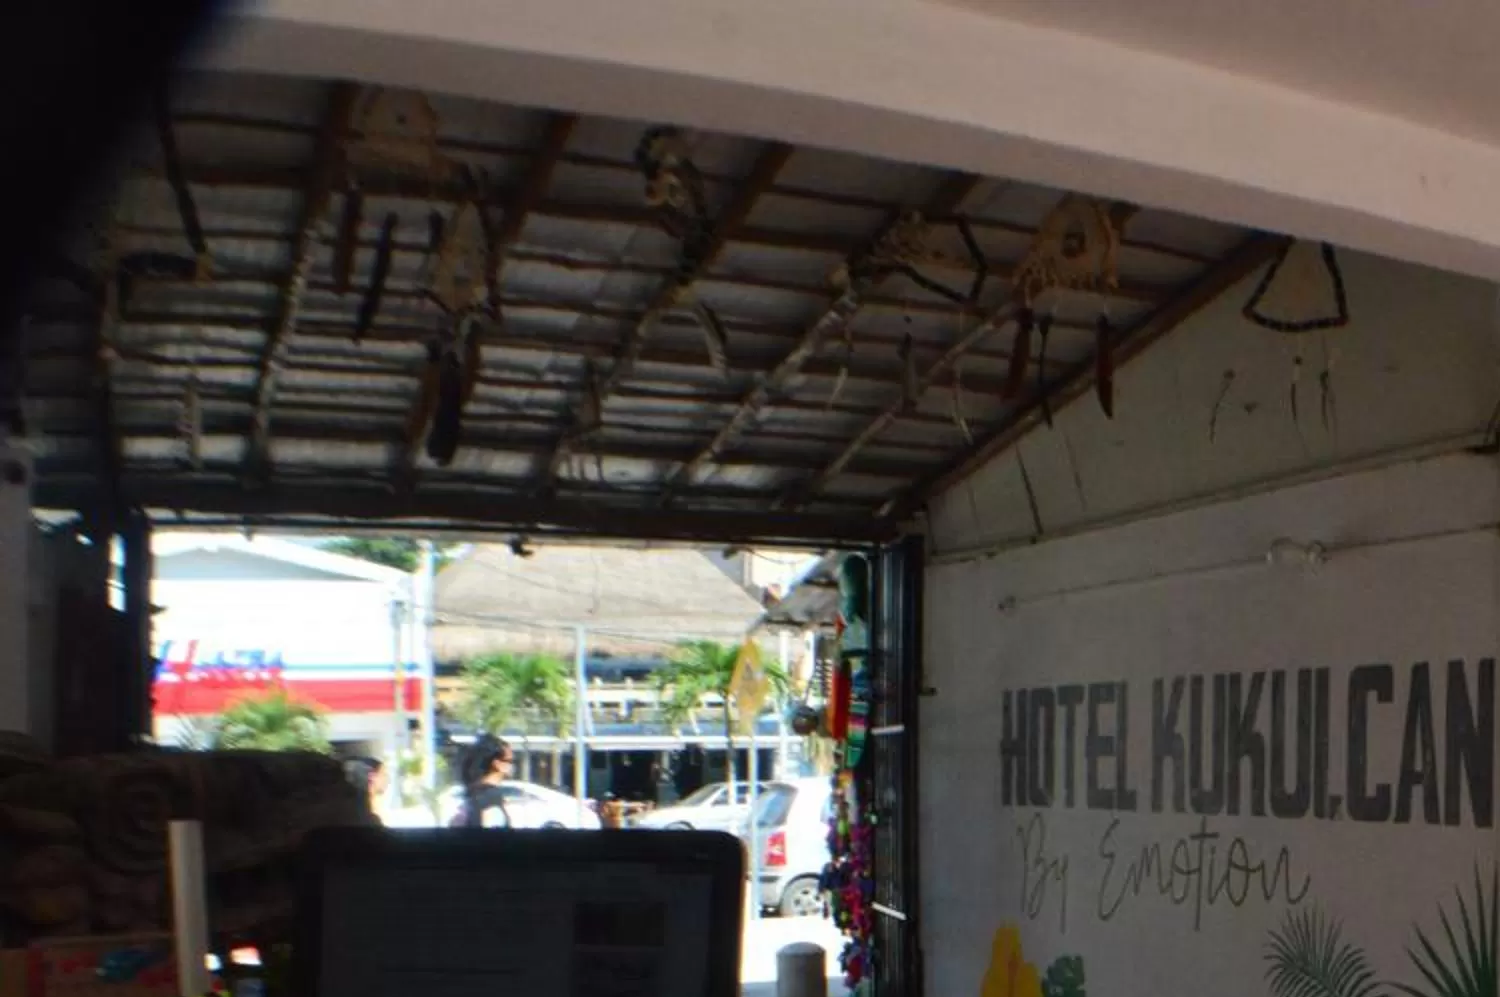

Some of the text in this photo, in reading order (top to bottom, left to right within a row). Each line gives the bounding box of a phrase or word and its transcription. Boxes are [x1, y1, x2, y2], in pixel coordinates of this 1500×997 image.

[1000, 657, 1496, 828] HOTEL KUKULCAN
[1017, 811, 1311, 934] By Emotion
